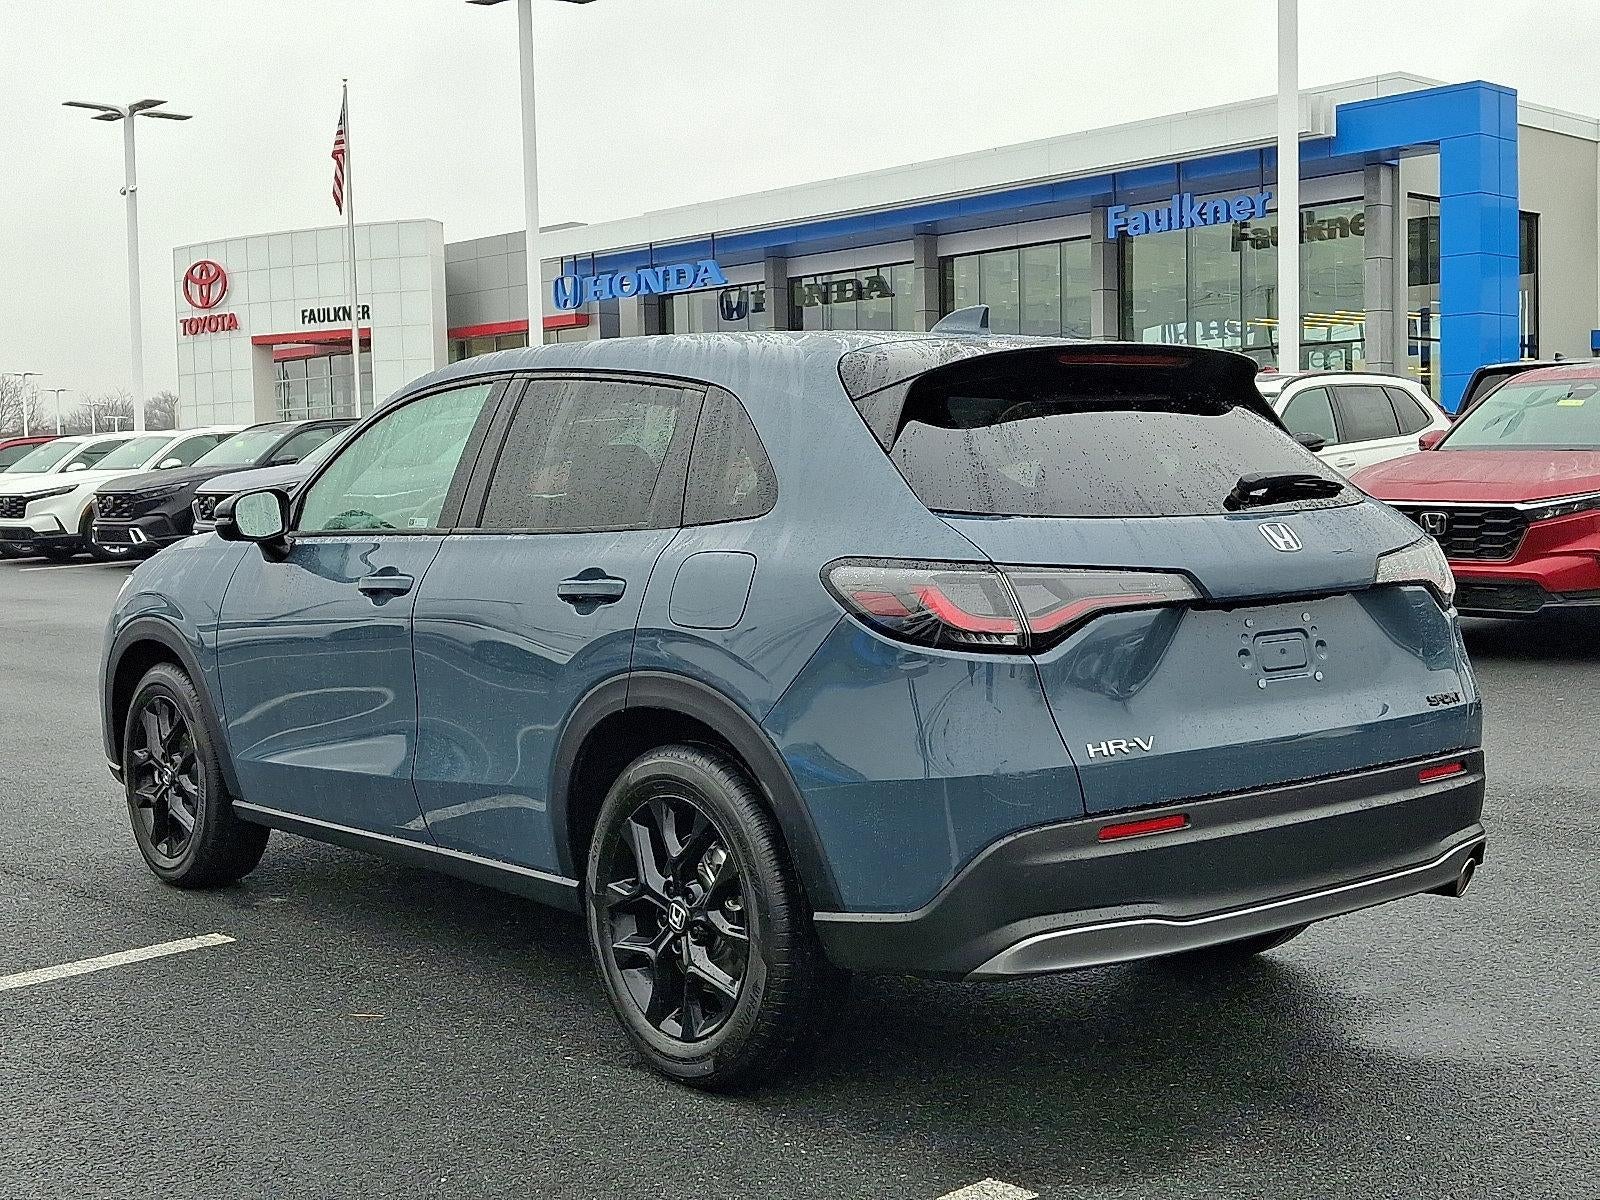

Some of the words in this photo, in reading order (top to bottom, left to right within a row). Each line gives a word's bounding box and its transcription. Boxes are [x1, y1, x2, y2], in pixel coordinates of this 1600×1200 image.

[1107, 191, 1273, 240] Faulkner
[583, 259, 728, 301] HONDA
[180, 313, 239, 337] TOYOTA
[301, 304, 371, 325] FAULKNER
[1086, 735, 1154, 758] HR-V
